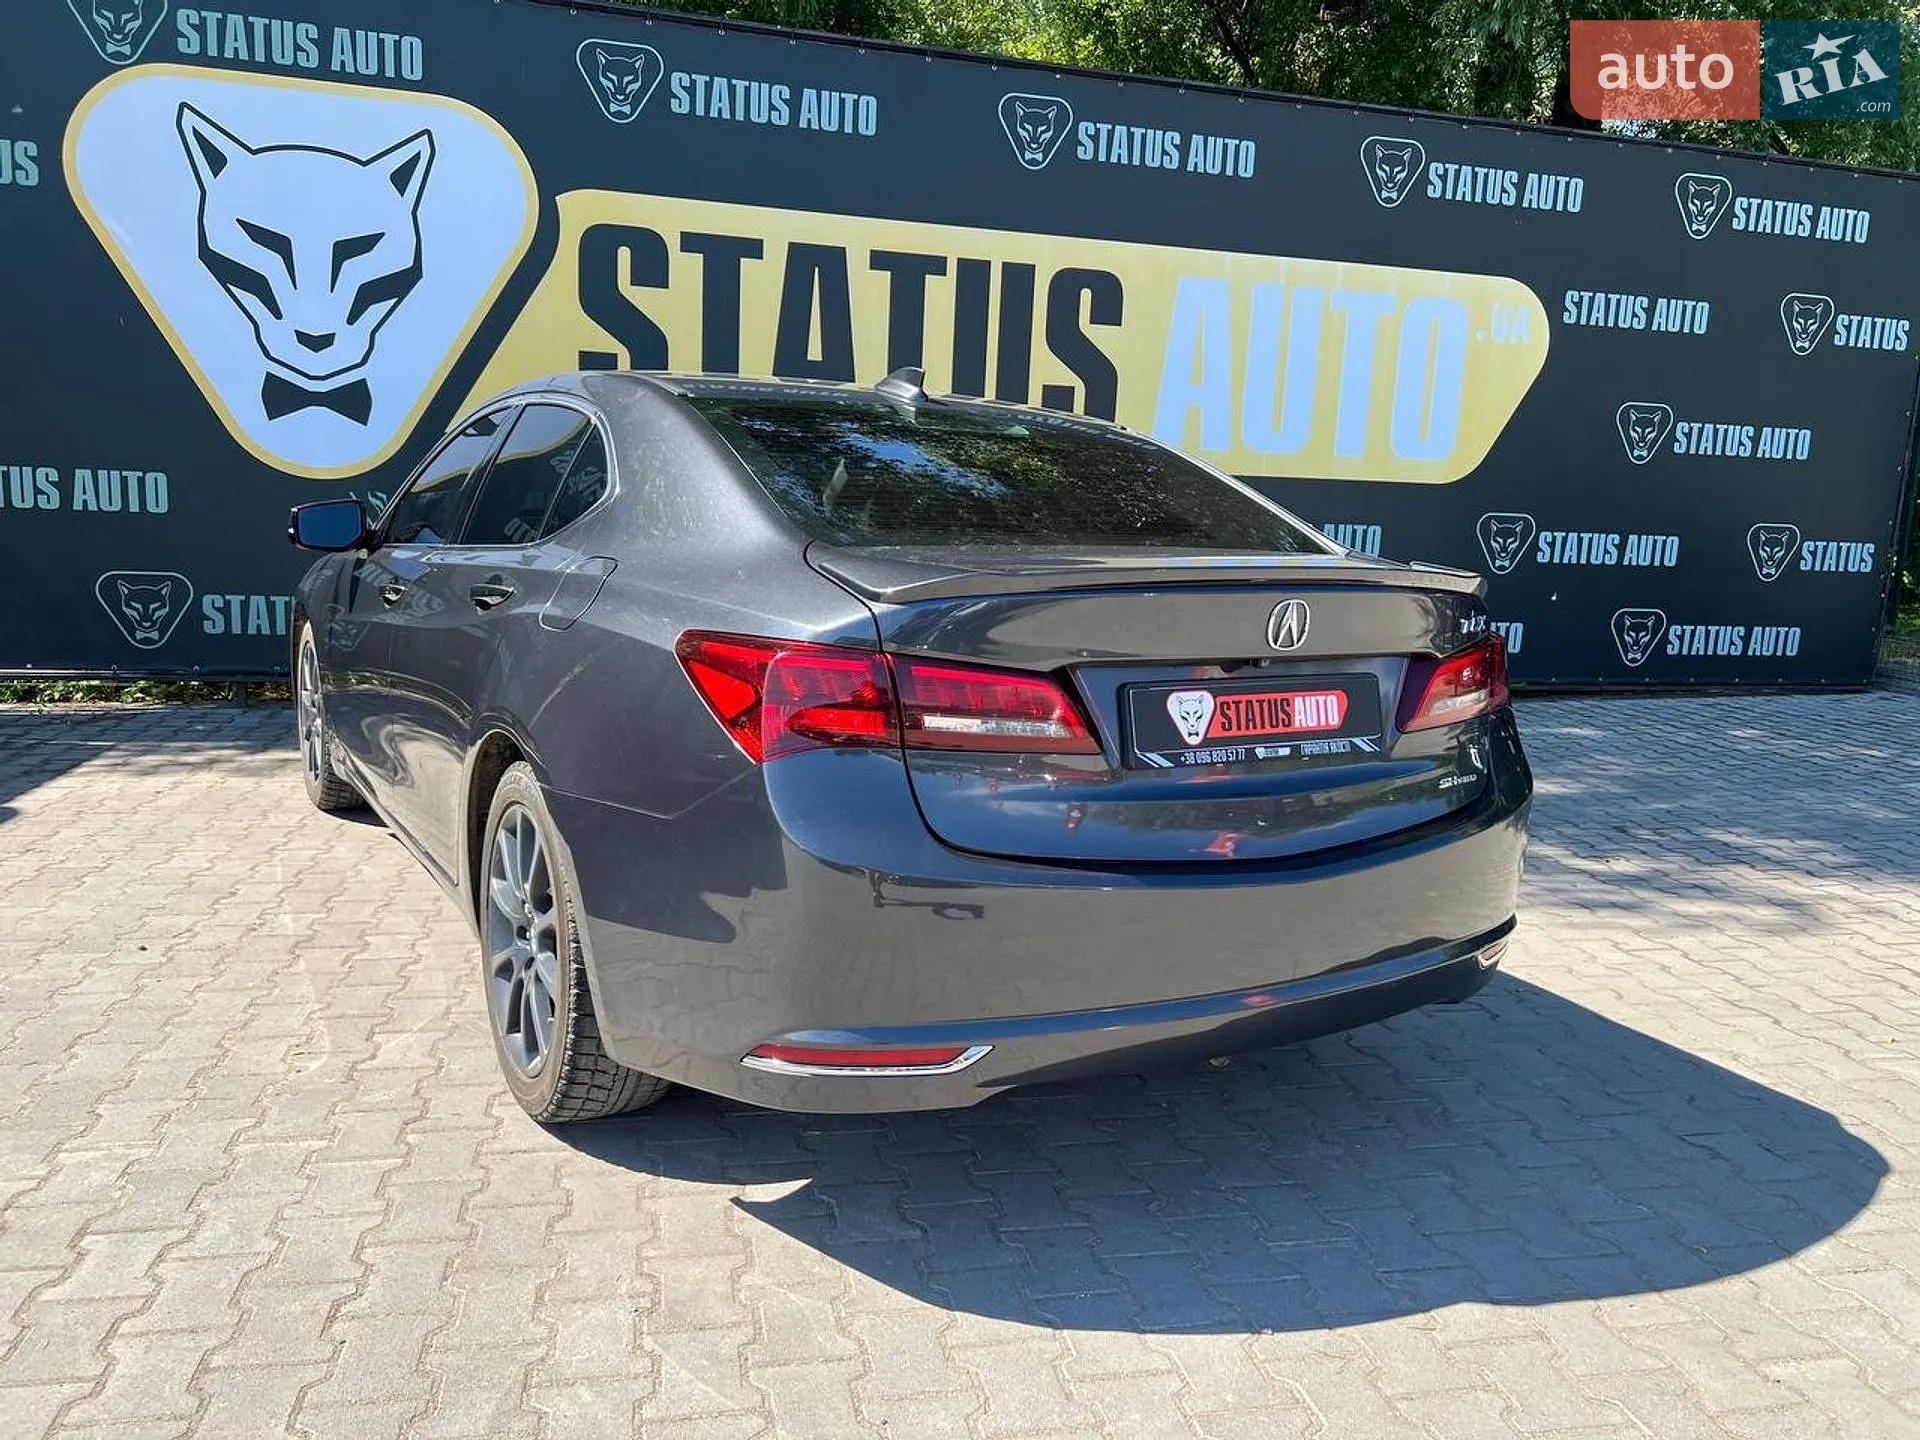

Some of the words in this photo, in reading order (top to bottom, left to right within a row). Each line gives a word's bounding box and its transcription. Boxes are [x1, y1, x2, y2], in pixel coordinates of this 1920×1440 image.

[177, 8, 320, 69] STATUS
[331, 29, 424, 81] AUTO
[670, 71, 791, 126] STATUS
[799, 87, 878, 137] AUTO
[1076, 121, 1181, 170] STATUS
[1186, 133, 1256, 178] AUTO
[1426, 161, 1519, 207] STATUS
[1522, 172, 1584, 213] AUTO
[1732, 196, 1814, 237] STATUS
[1816, 205, 1870, 243] AUTO
[1562, 289, 1649, 330] STATUS
[1652, 297, 1710, 335] AUTO
[1833, 313, 1909, 351] STATUS
[577, 223, 1124, 423] STATUS
[1153, 276, 1470, 461] AUTO
[1673, 421, 1755, 457] STATUS
[1756, 427, 1812, 460] AUTO
[72, 468, 169, 514] AUTO
[1537, 531, 1620, 566] STATUS
[1622, 535, 1680, 567] AUTO
[1800, 540, 1875, 573] STATUS
[202, 594, 297, 636] STAT
[1666, 624, 1746, 656] STATUS
[1747, 626, 1801, 657] AUTO
[1220, 697, 1292, 732] STATUS
[1294, 694, 1340, 728] AUTO
